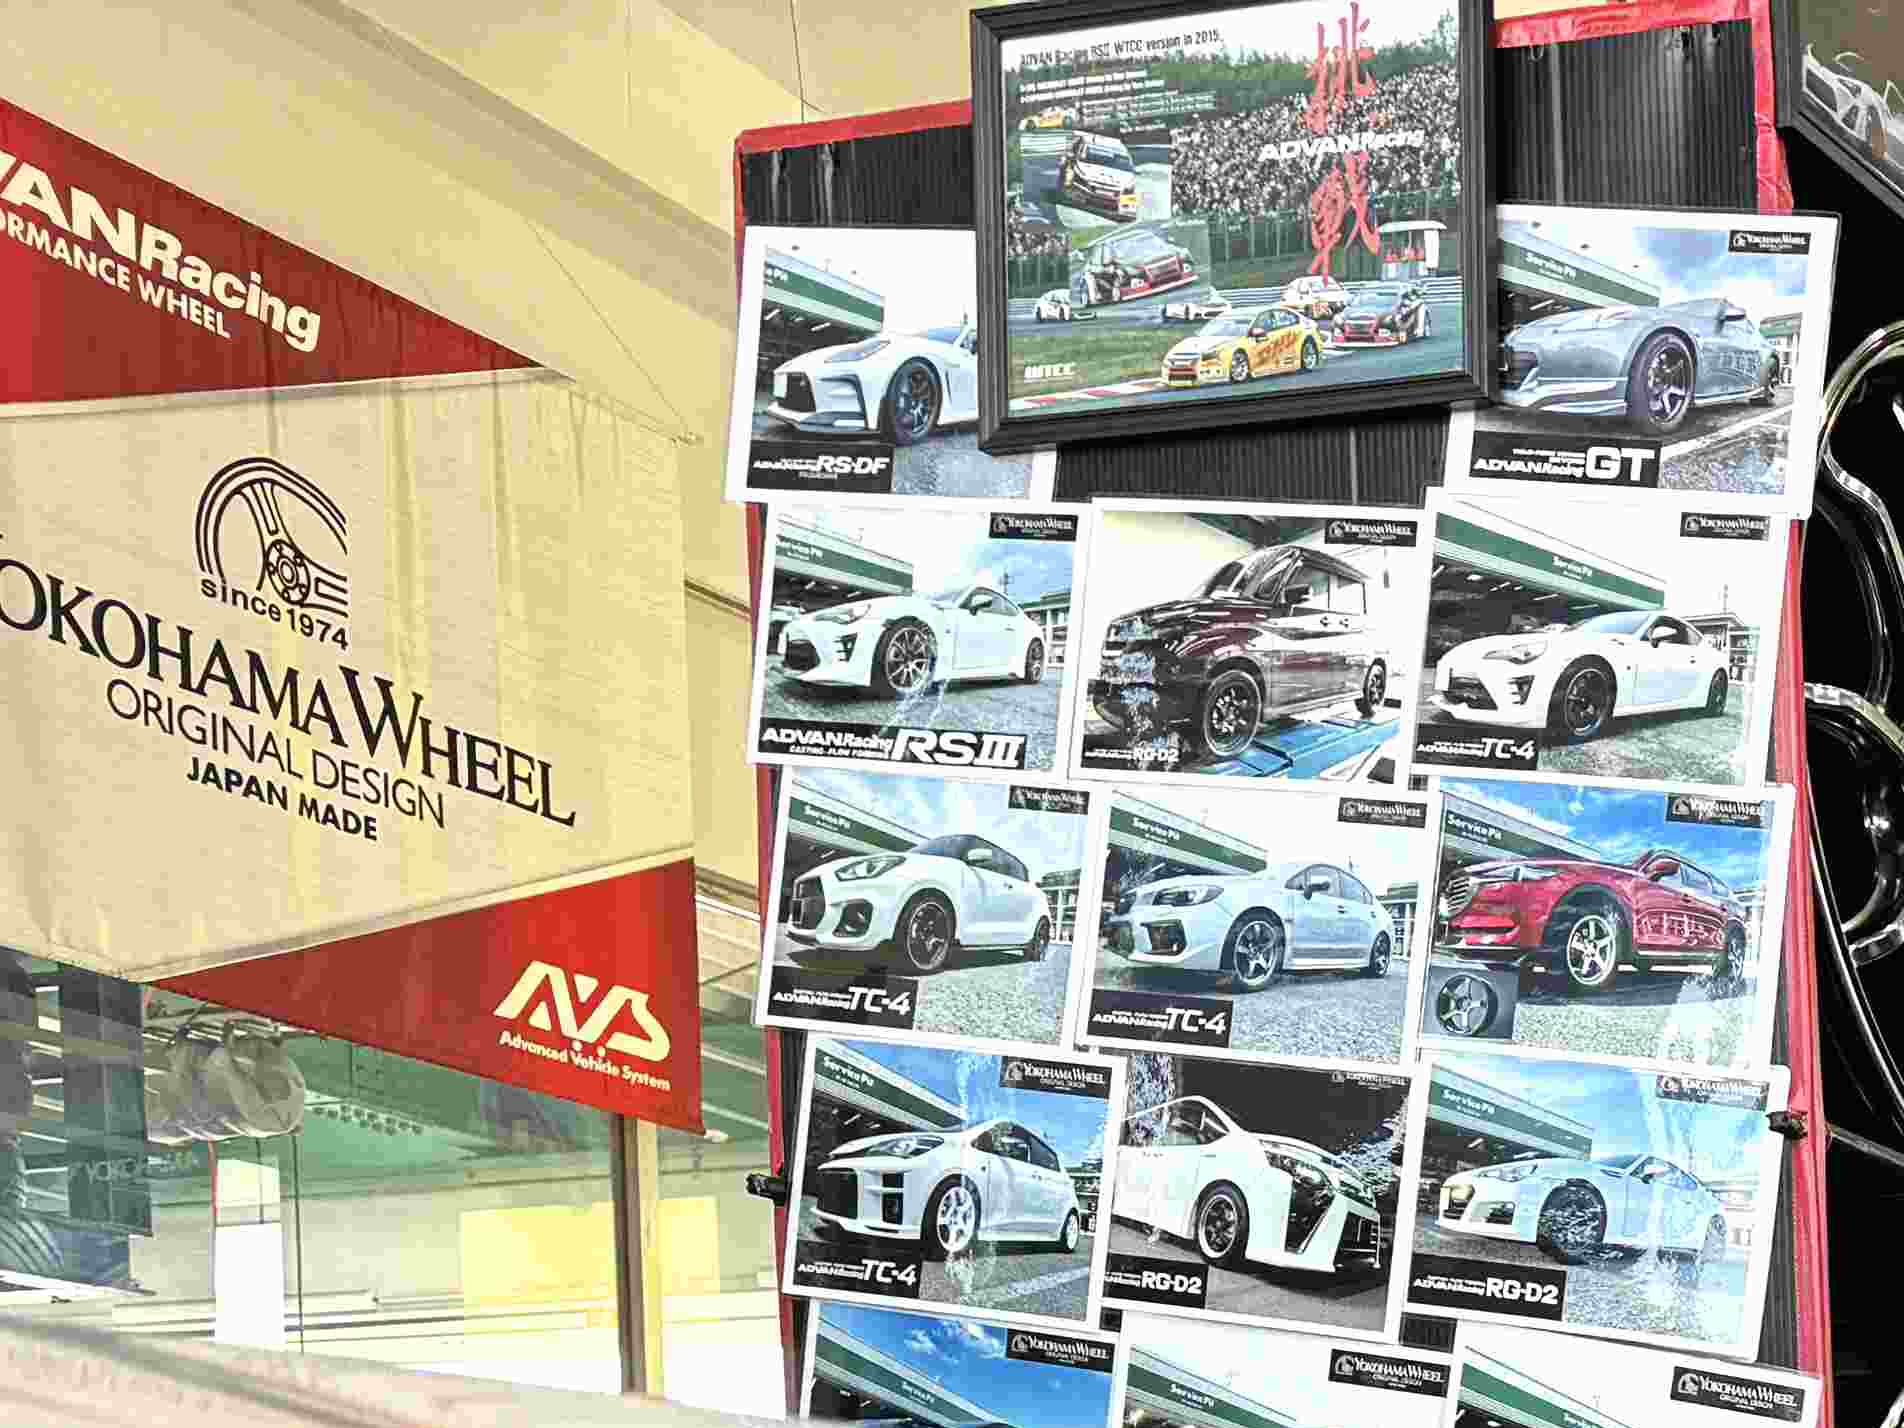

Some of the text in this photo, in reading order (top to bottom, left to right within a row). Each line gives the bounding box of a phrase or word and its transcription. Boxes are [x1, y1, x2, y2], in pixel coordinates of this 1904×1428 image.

[137, 273, 231, 339] WHEEL
[1585, 447, 1655, 482] GT
[199, 575, 349, 650] since 1974
[105, 675, 446, 830] ORIGINAL DESIGN
[341, 649, 577, 827] WHEEL
[1481, 738, 1536, 761] TC-4
[186, 755, 378, 842] JAPAN MADE
[849, 986, 912, 1016] TC-4
[1166, 1008, 1227, 1035] TC-4
[499, 1028, 672, 1093] Advanced Vehicle System
[861, 1259, 918, 1287] TC-4
[1141, 1271, 1204, 1295] RG-D2
[1485, 1276, 1559, 1306] RG-D2
